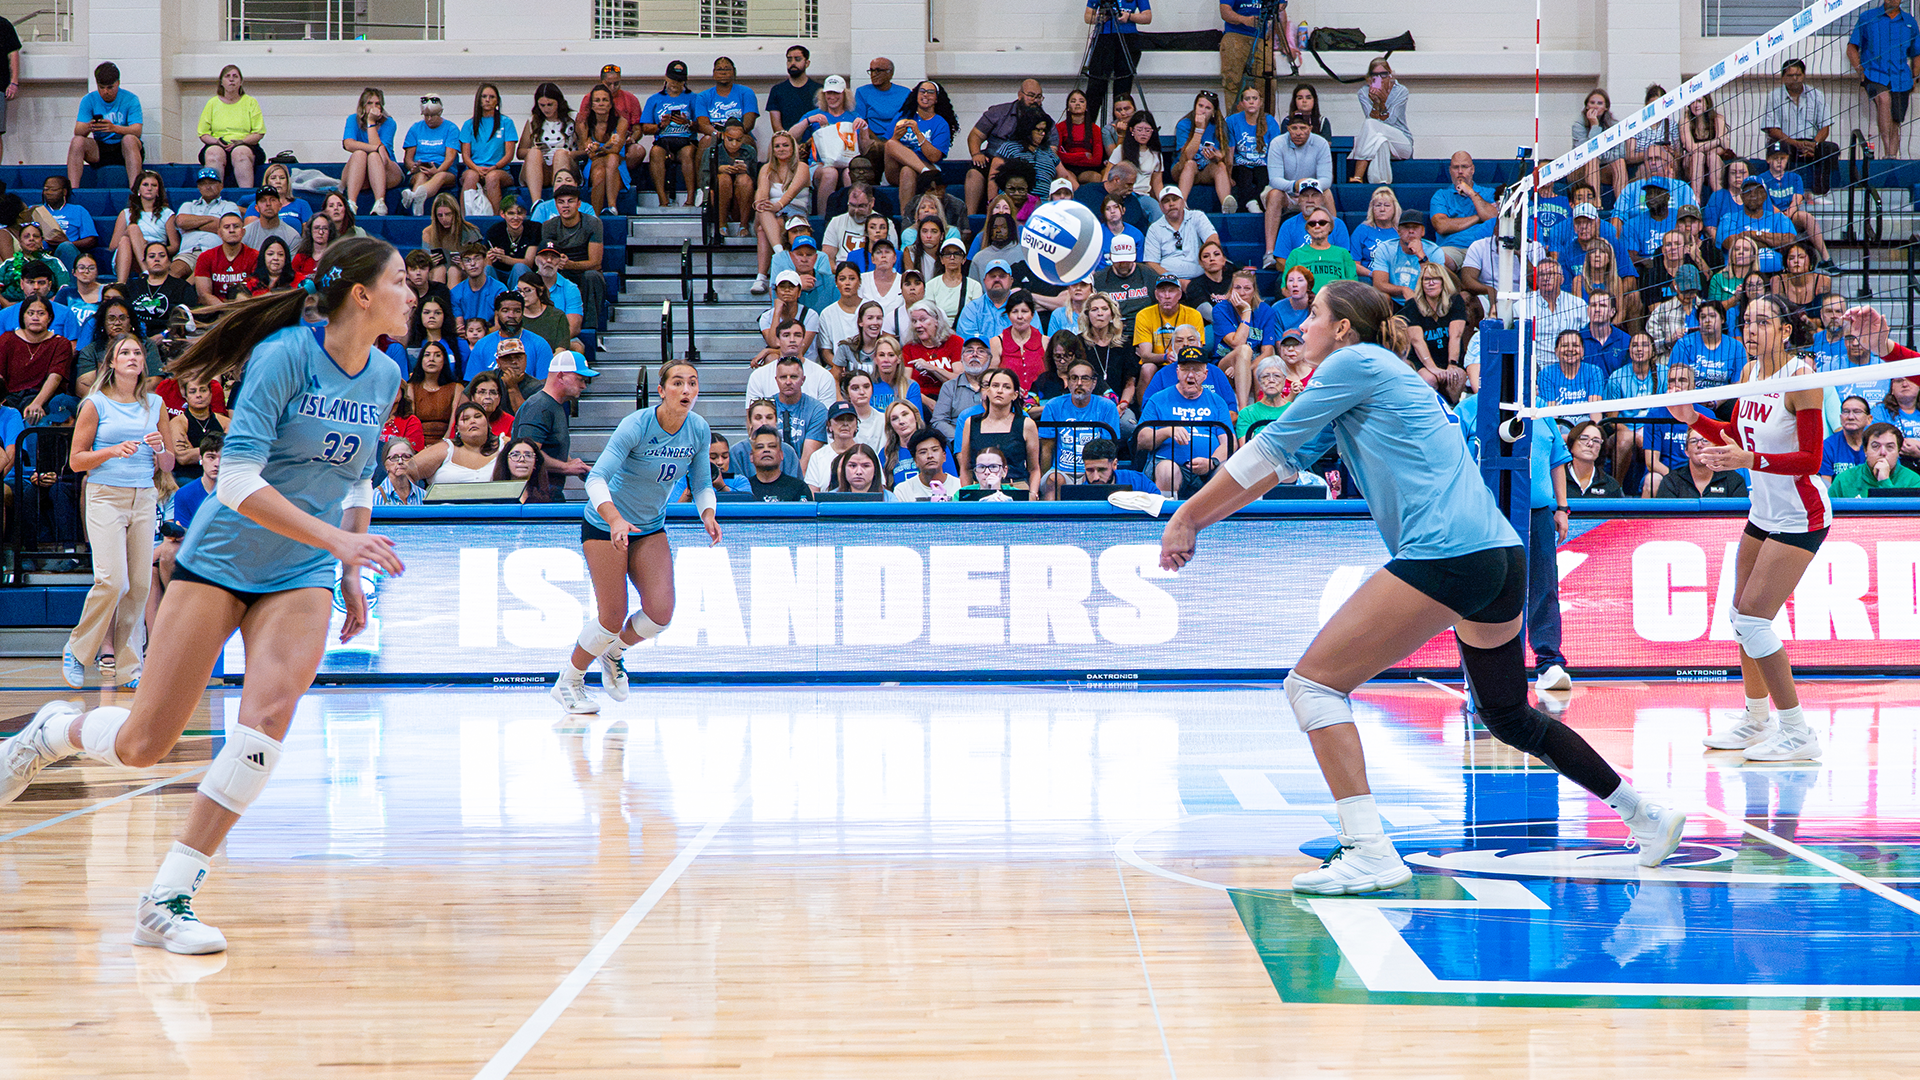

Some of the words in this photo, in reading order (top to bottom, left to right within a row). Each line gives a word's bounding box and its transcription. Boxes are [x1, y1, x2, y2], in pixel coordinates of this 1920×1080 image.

[298, 392, 380, 428] ISLANDER
[1172, 406, 1196, 418] LET'S
[1197, 407, 1211, 417] GO
[1739, 400, 1773, 424] UIW
[1744, 426, 1755, 452] 5
[656, 463, 677, 484] 18
[459, 544, 1180, 648] ISANDERS
